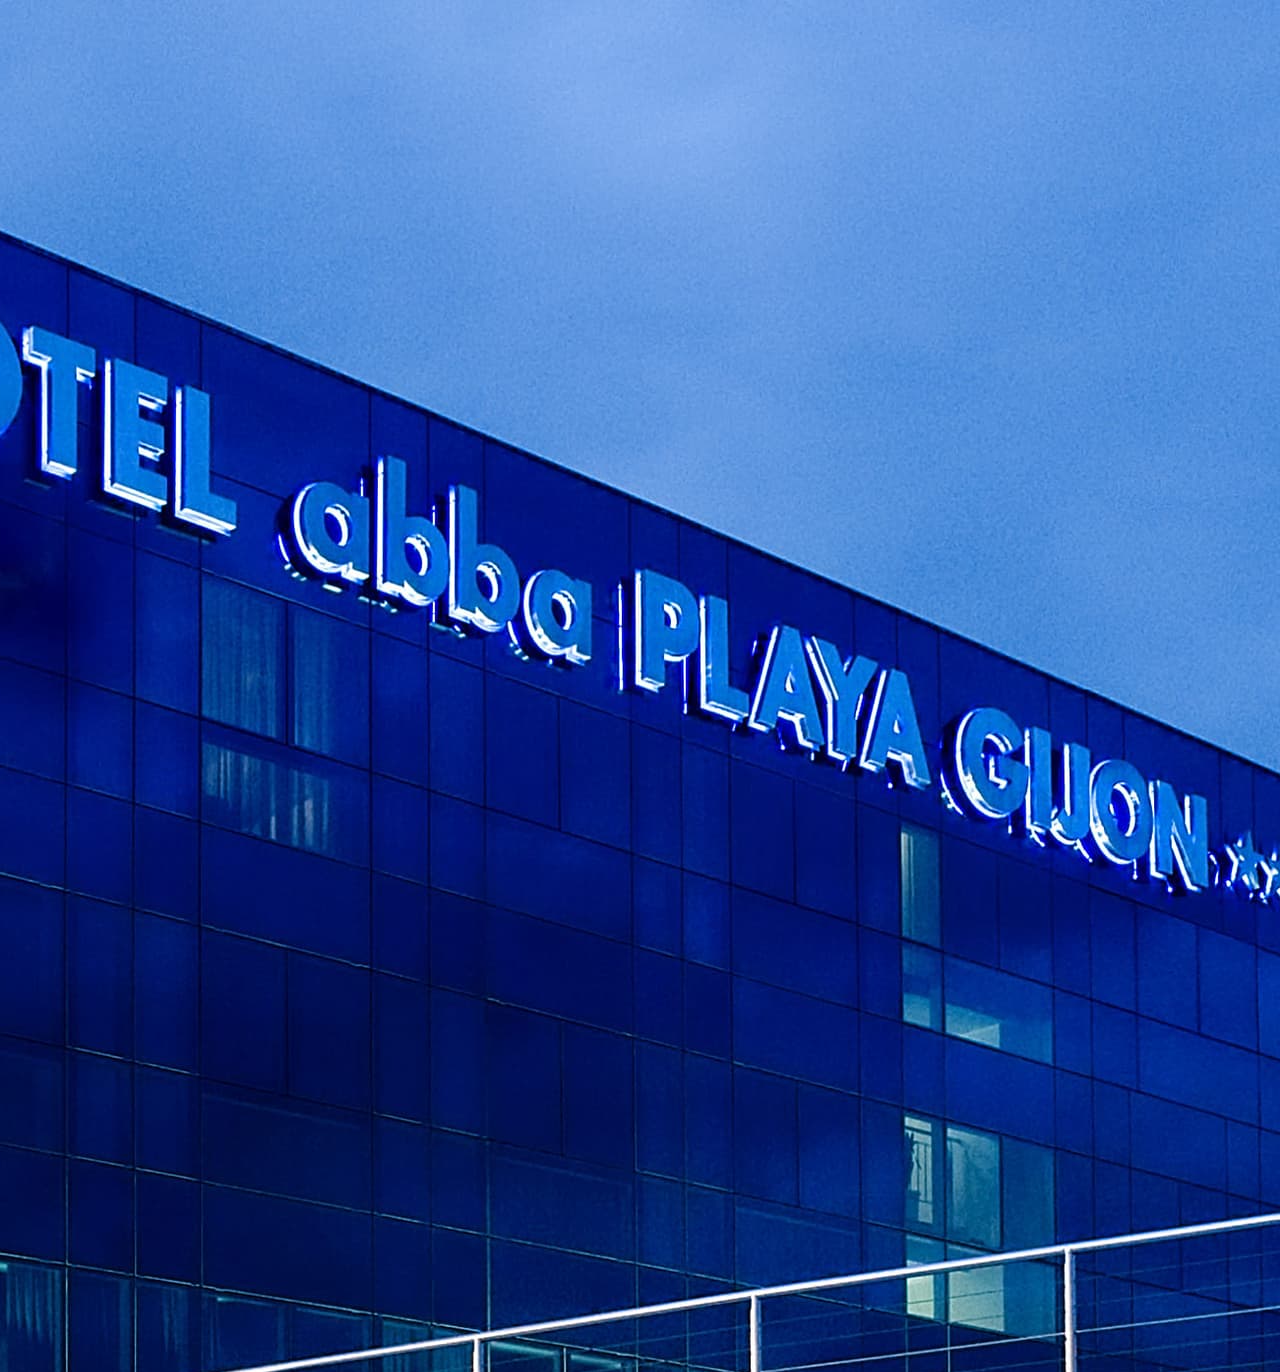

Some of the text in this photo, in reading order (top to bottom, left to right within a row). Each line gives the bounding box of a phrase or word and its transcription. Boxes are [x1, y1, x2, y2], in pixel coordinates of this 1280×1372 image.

[292, 455, 592, 665] abba
[635, 568, 932, 790] PLAYA
[955, 707, 1209, 892] GIJON
